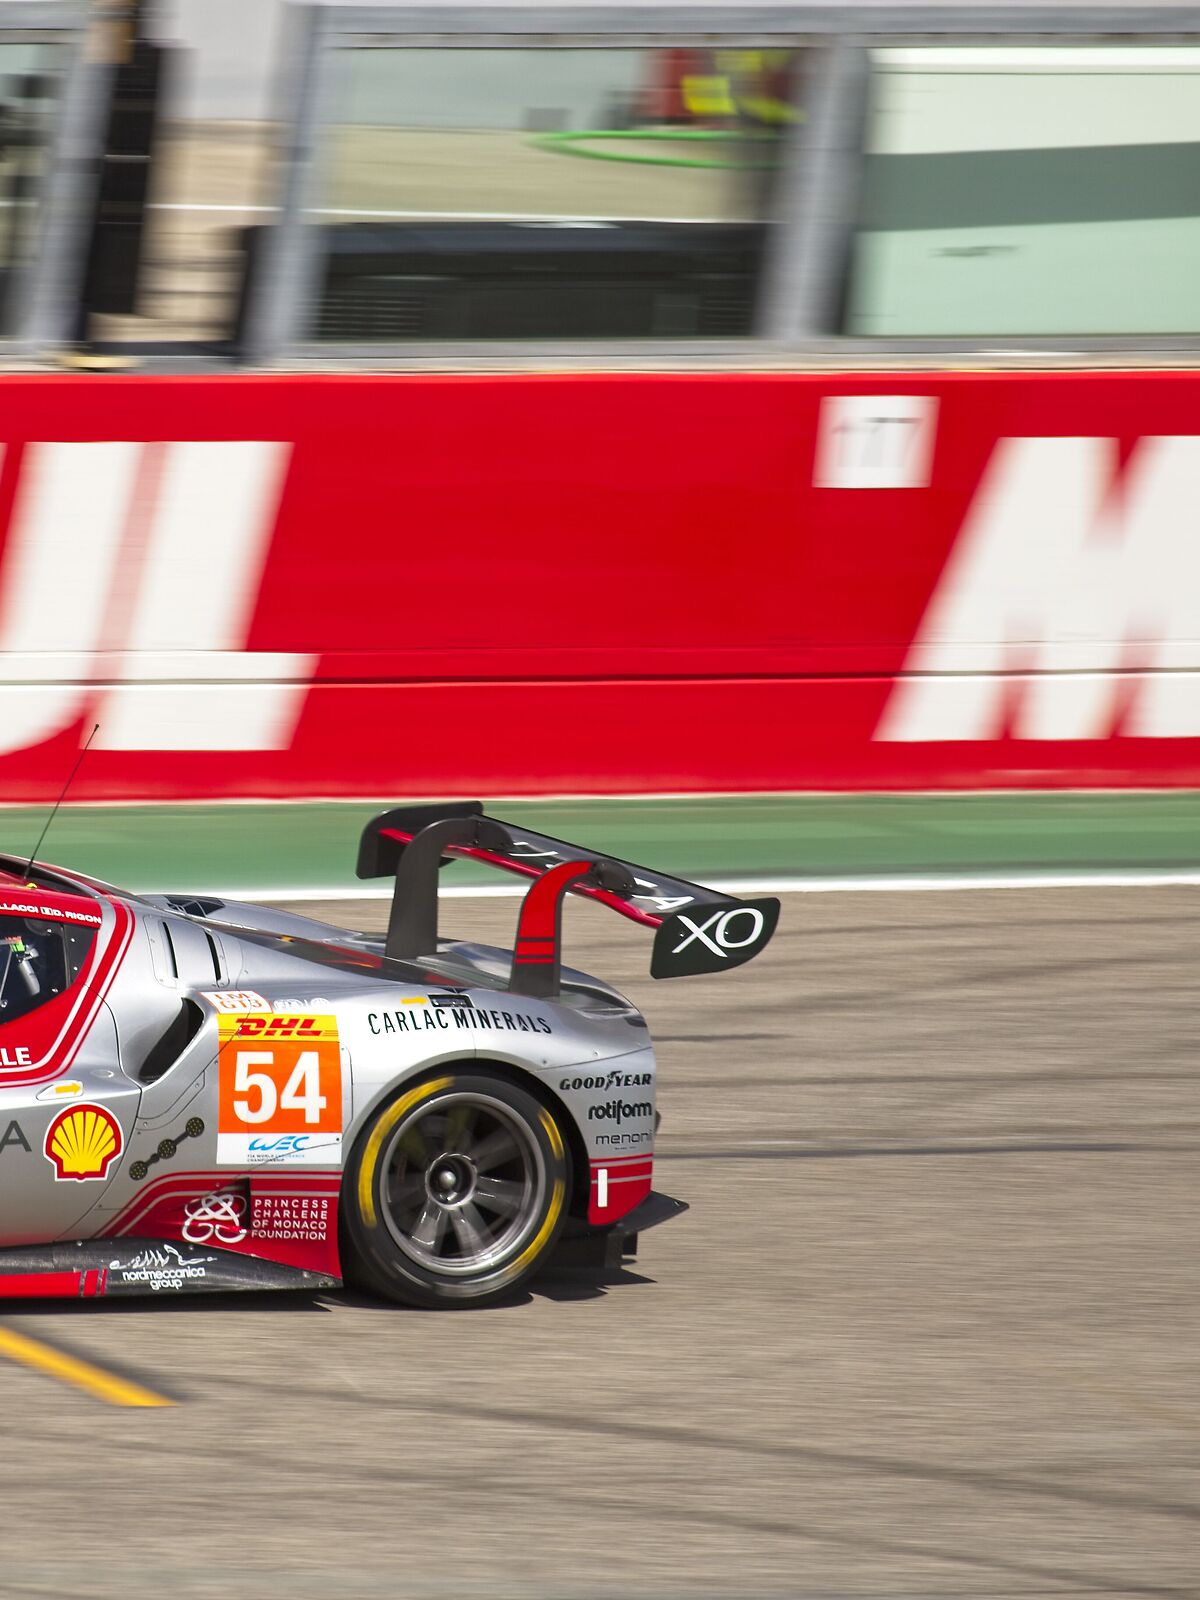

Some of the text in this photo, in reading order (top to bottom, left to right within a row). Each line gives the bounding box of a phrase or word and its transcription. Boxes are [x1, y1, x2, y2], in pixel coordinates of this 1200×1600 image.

[65, 911, 103, 924] RIGON
[672, 907, 764, 958] XO
[236, 1018, 322, 1037] DHL
[367, 1007, 553, 1035] CARLAC MINERALS
[233, 1051, 327, 1124] 54
[559, 1070, 652, 1091] GOODYEAR
[588, 1099, 653, 1125] rotiform
[249, 1135, 310, 1151] WEC
[254, 1199, 329, 1209] PRINCESS
[253, 1209, 328, 1220] CHARLENE
[252, 1219, 327, 1230] OF MONACO
[251, 1230, 327, 1240] FOUNDATION
[122, 1265, 206, 1282] nordmeccanica
[149, 1277, 183, 1291] group
